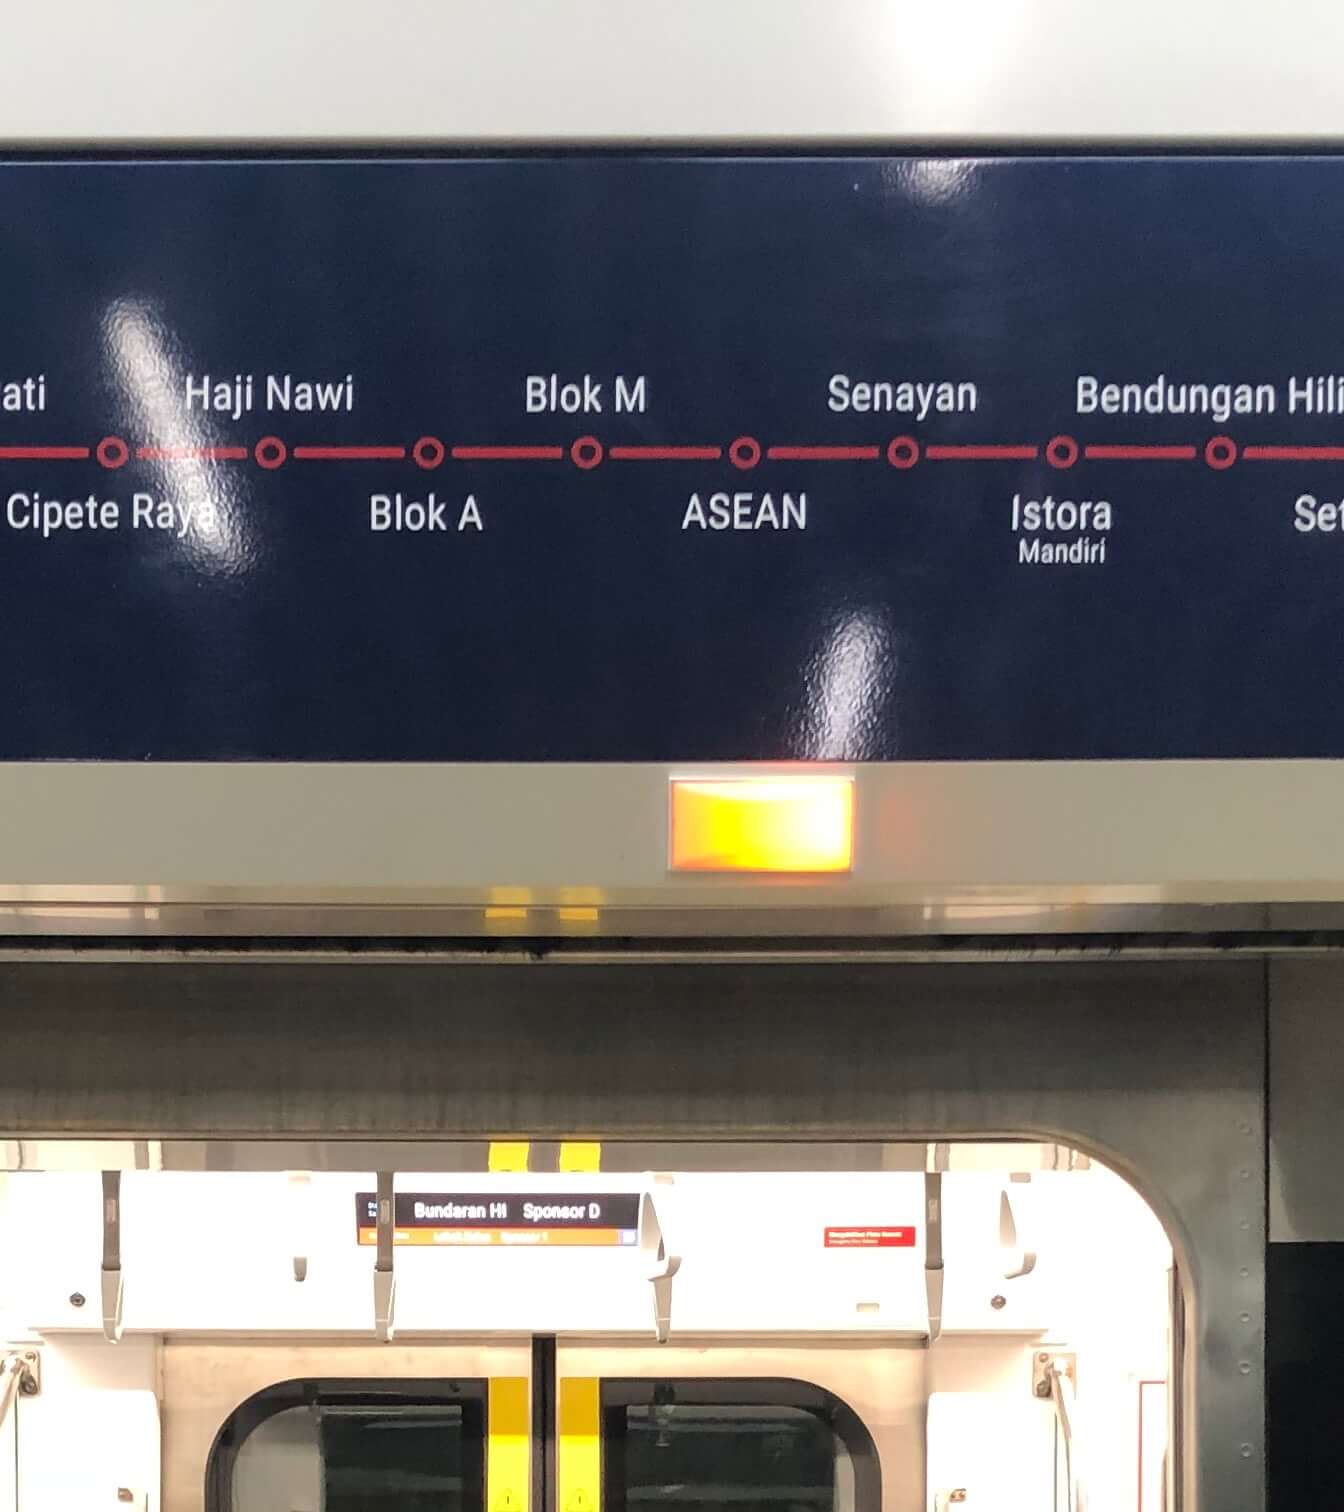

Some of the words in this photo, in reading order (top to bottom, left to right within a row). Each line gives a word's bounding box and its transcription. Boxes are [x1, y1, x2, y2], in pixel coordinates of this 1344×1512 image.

[184, 373, 254, 421] Haji
[267, 374, 353, 411] Nawi
[526, 373, 602, 413] Blok
[615, 375, 645, 413] M
[828, 374, 977, 421] Senayan
[1077, 374, 1275, 422] Bendungan
[7, 492, 119, 538] Cipete
[131, 492, 217, 539] Raya
[370, 493, 447, 531] Blok
[458, 495, 483, 531] A
[681, 492, 806, 530] ASEAN
[1011, 494, 1111, 531] Istora
[1018, 537, 1106, 564] Mandiri
[415, 1202, 486, 1218] Bundaran
[490, 1203, 507, 1218] HI
[524, 1203, 585, 1222] Sponsor
[589, 1203, 600, 1218] D
